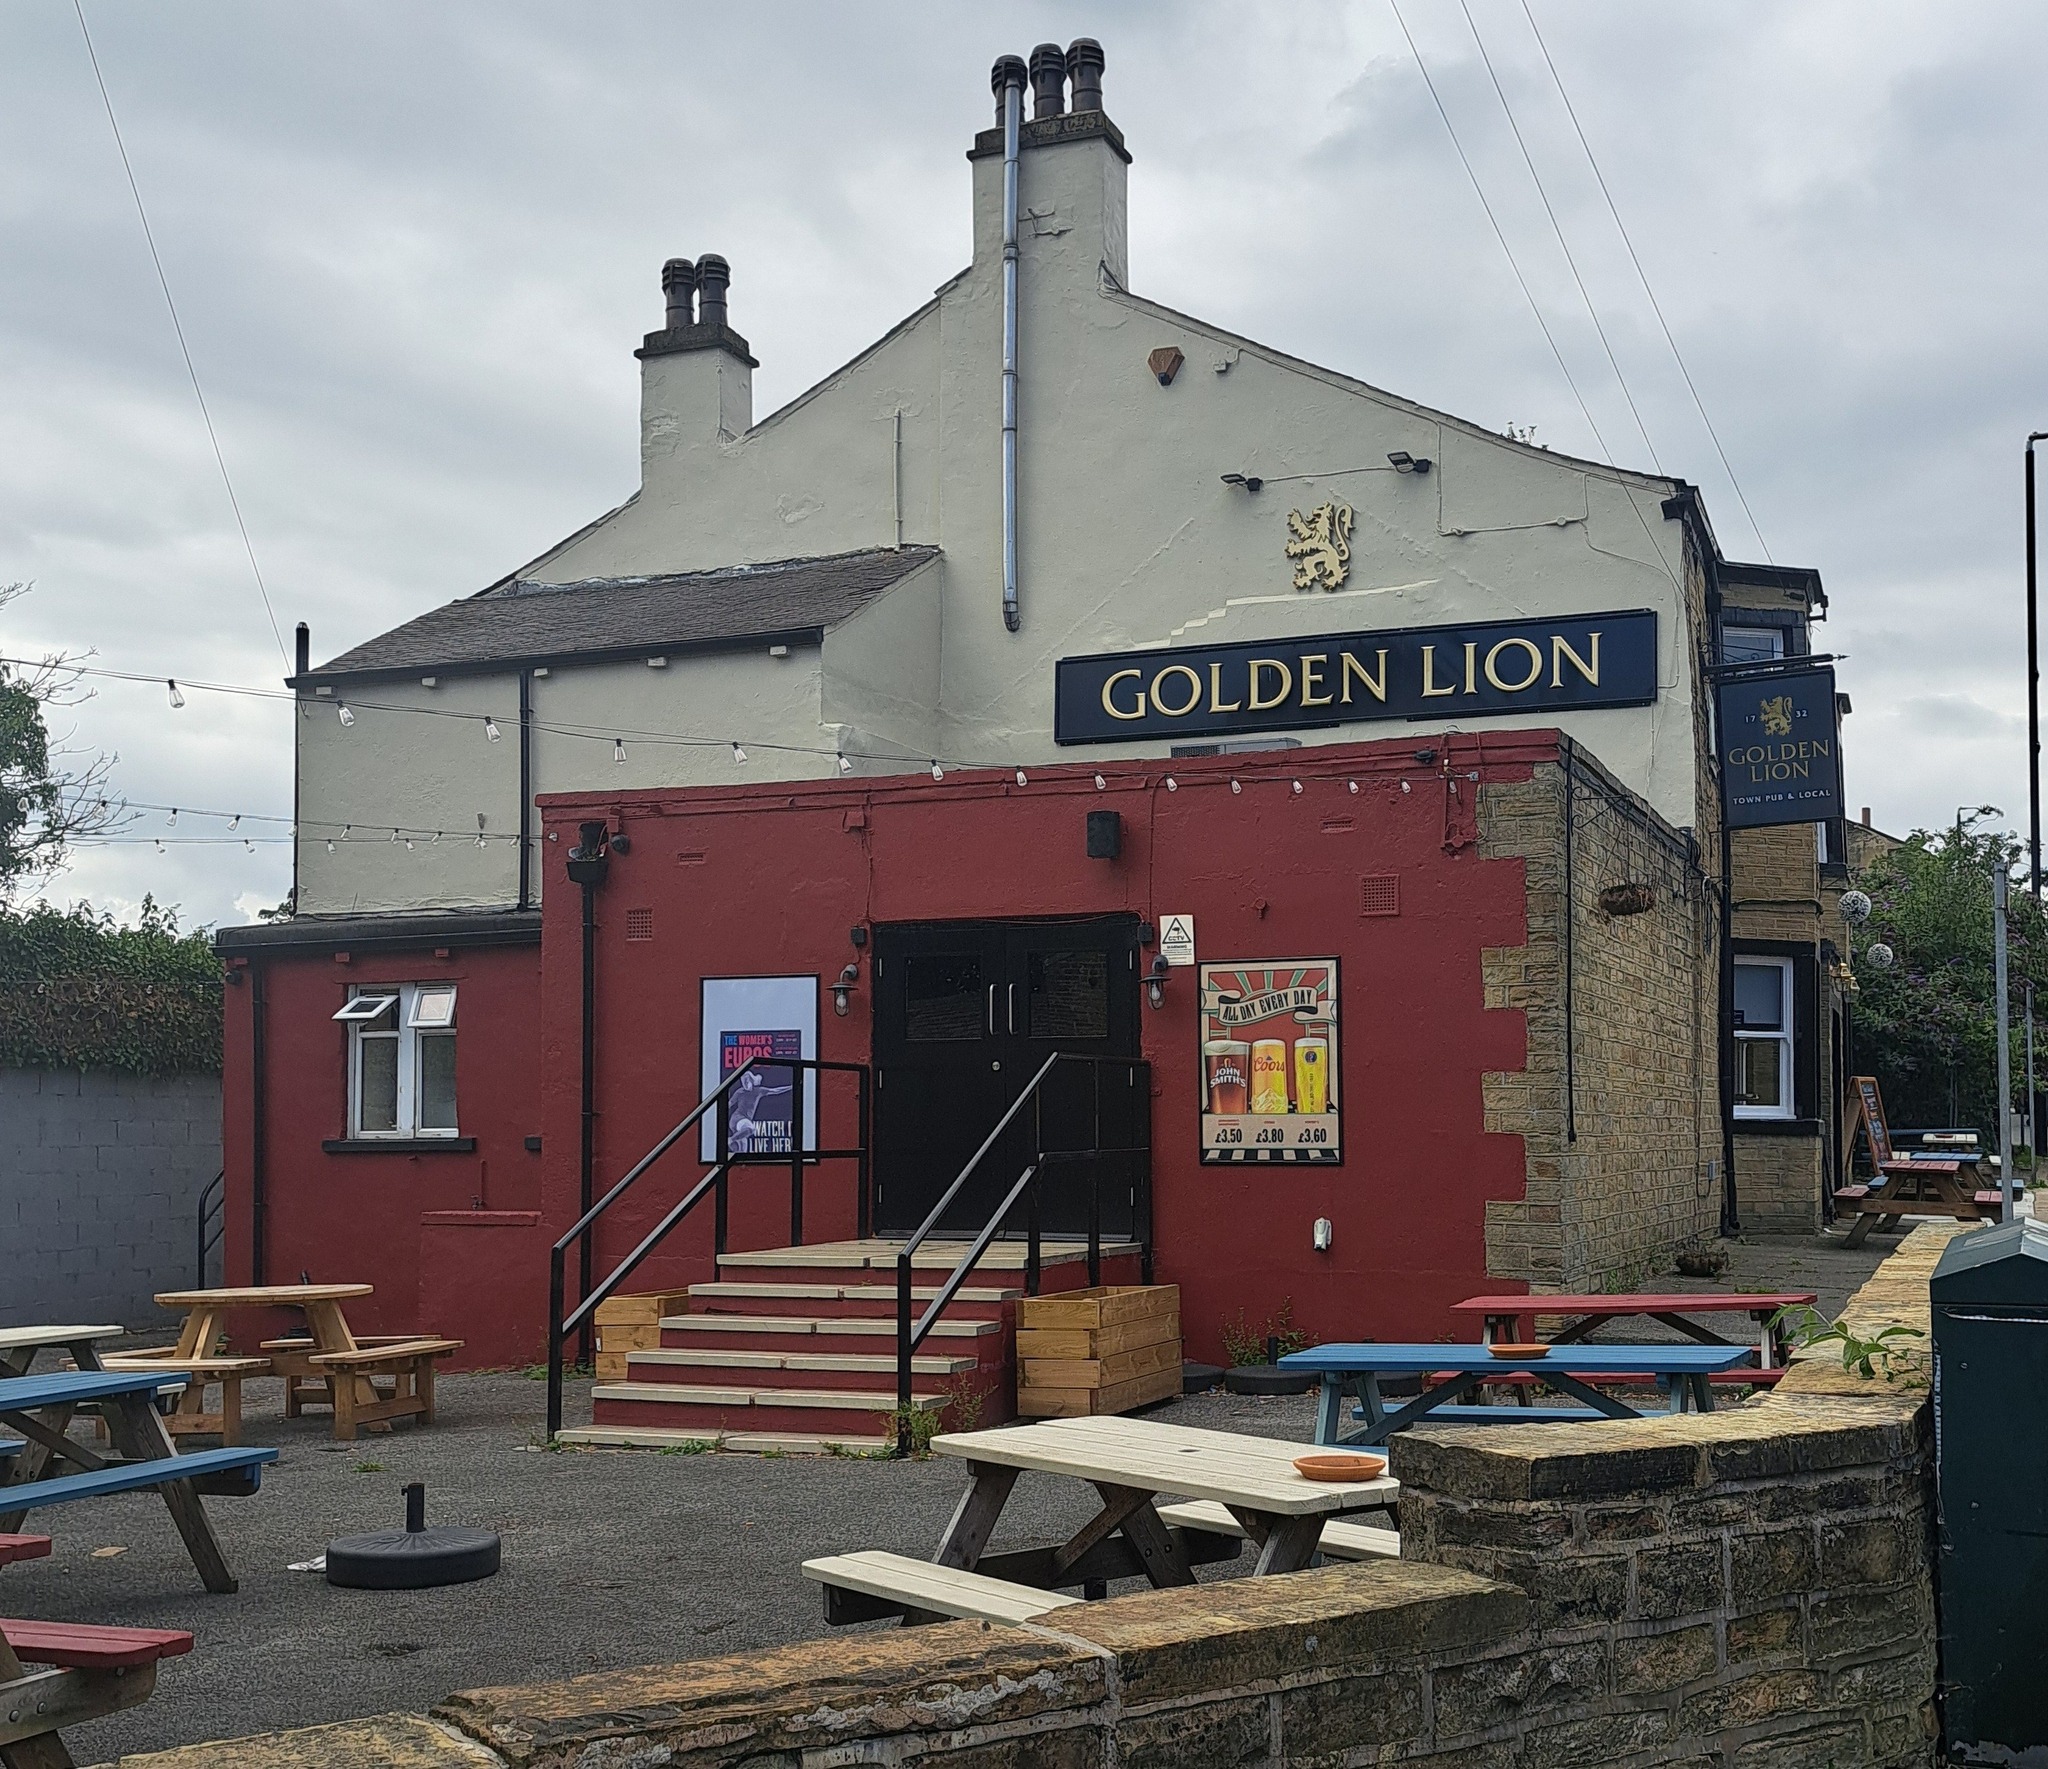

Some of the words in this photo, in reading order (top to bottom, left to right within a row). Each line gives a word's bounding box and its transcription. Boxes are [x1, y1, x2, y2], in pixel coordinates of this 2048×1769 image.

[1100, 648, 1390, 721] GOLDEN
[1420, 632, 1603, 698] LION
[1745, 715, 1756, 723] 17
[1795, 709, 1808, 718] 32
[1728, 739, 1829, 765] GOLDEN
[1751, 760, 1810, 782] LION
[1733, 796, 1762, 805] TOWN
[1765, 793, 1784, 802] PUB
[1787, 792, 1795, 800] &
[1799, 789, 1831, 799] LOCAL
[1222, 1006, 1239, 1021] ALL
[1240, 1003, 1257, 1020] DAY
[1259, 992, 1290, 1013] EVERY
[1294, 989, 1313, 1005] DAY
[725, 1035, 738, 1045] THE
[739, 1034, 773, 1045] WOMEN'S
[1214, 1066, 1241, 1078] JOHN
[1253, 1057, 1285, 1072] Coors
[1210, 1075, 1247, 1089] SMITH'S
[753, 1120, 785, 1137] WATCH
[1215, 1128, 1243, 1144] £3.50
[1255, 1128, 1284, 1144] £3.80
[1298, 1127, 1327, 1144] £3.60
[749, 1138, 771, 1152] LIVE
[772, 1137, 793, 1152] HER
